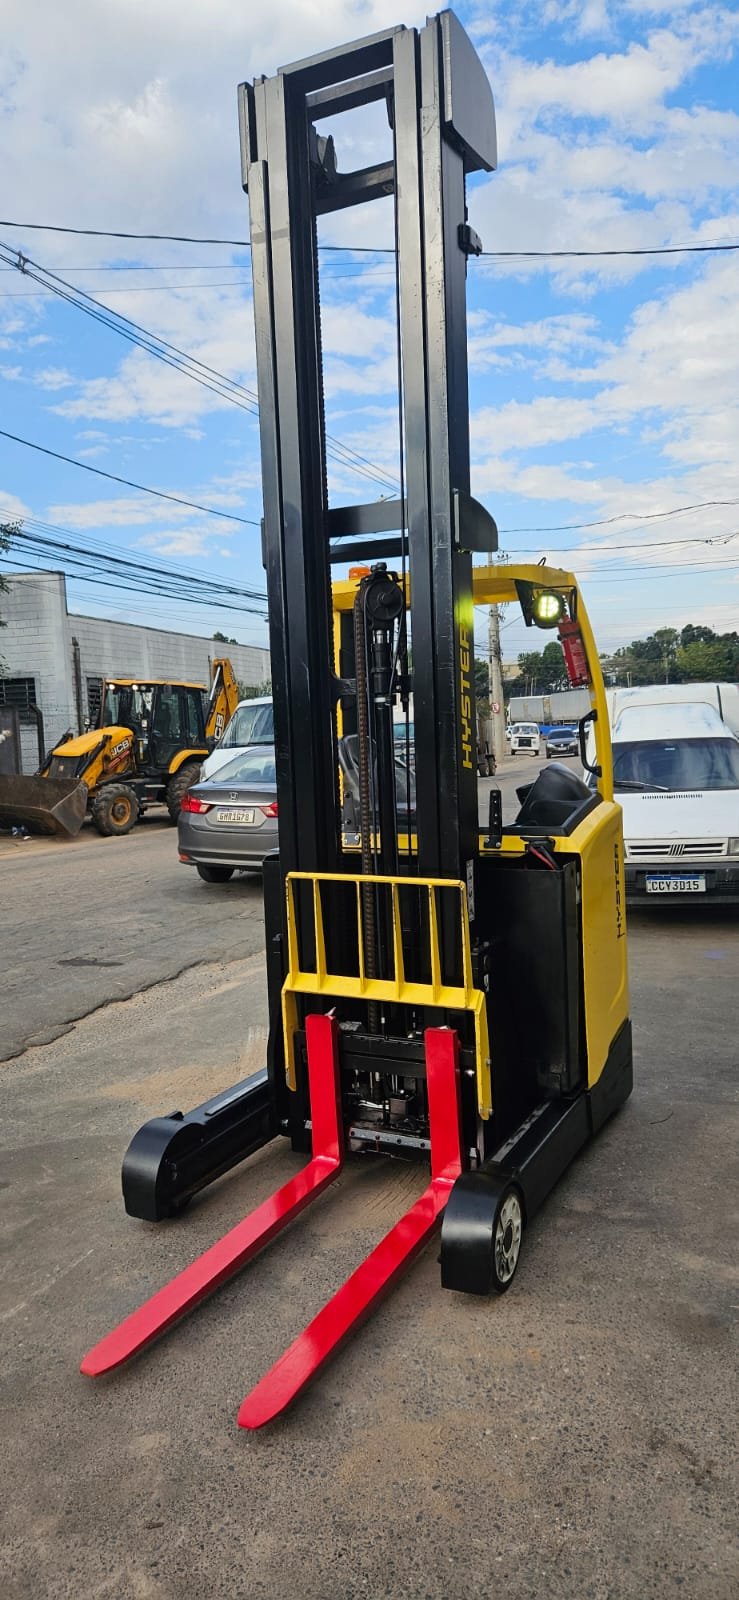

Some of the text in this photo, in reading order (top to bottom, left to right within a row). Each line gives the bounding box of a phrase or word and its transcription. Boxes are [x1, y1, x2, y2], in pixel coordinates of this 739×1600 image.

[459, 622, 472, 769] HYSTER
[214, 713, 224, 741] CB
[111, 739, 129, 756] JCB
[614, 843, 625, 938] HYSTER
[651, 880, 700, 891] CCY3D15
